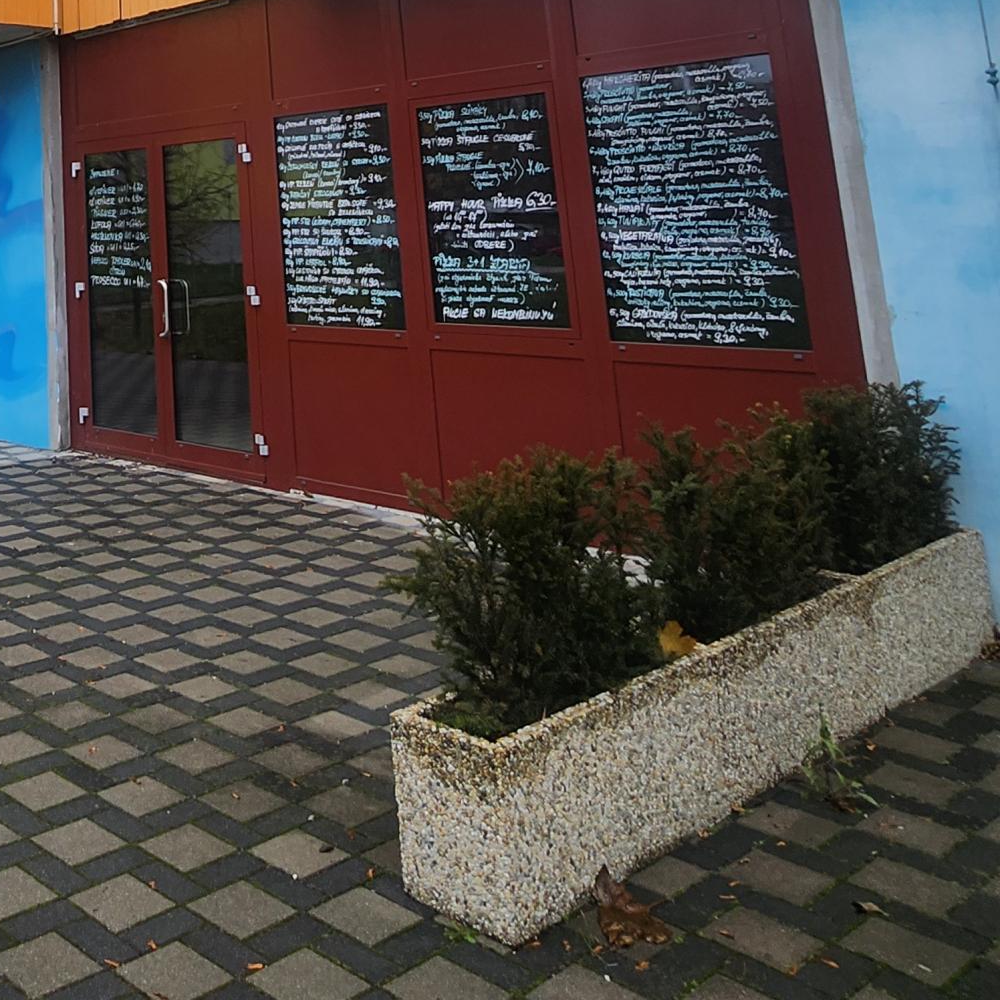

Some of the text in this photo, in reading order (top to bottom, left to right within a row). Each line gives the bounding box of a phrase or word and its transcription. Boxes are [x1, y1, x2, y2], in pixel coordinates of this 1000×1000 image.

[461, 198, 486, 209] HOUR
[491, 192, 523, 208] PIZZA
[467, 256, 485, 268] 3+1
[443, 304, 469, 322] AKCIE
[473, 307, 486, 318] SA
